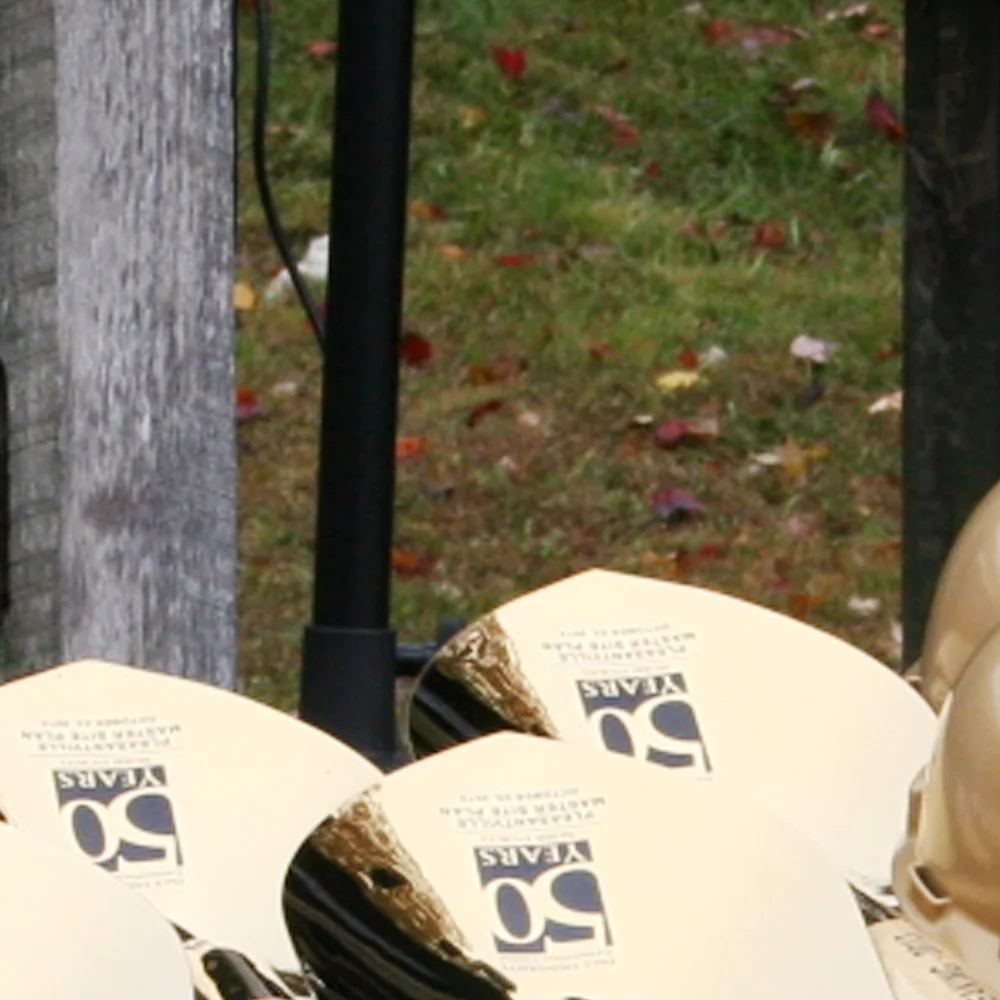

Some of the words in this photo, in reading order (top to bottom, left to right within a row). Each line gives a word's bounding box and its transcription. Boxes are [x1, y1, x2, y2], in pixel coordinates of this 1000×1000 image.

[582, 675, 683, 699] YEARS
[72, 731, 106, 741] SITE
[112, 725, 181, 739] MASTER
[57, 767, 163, 789] YEARS
[439, 806, 484, 817] PLAN
[492, 805, 528, 816] SITE
[533, 797, 606, 815] MASTER
[60, 785, 181, 872] 50
[457, 810, 595, 829] PLEASANTVILLE
[479, 842, 588, 867] YEARS
[484, 861, 608, 953] 50
